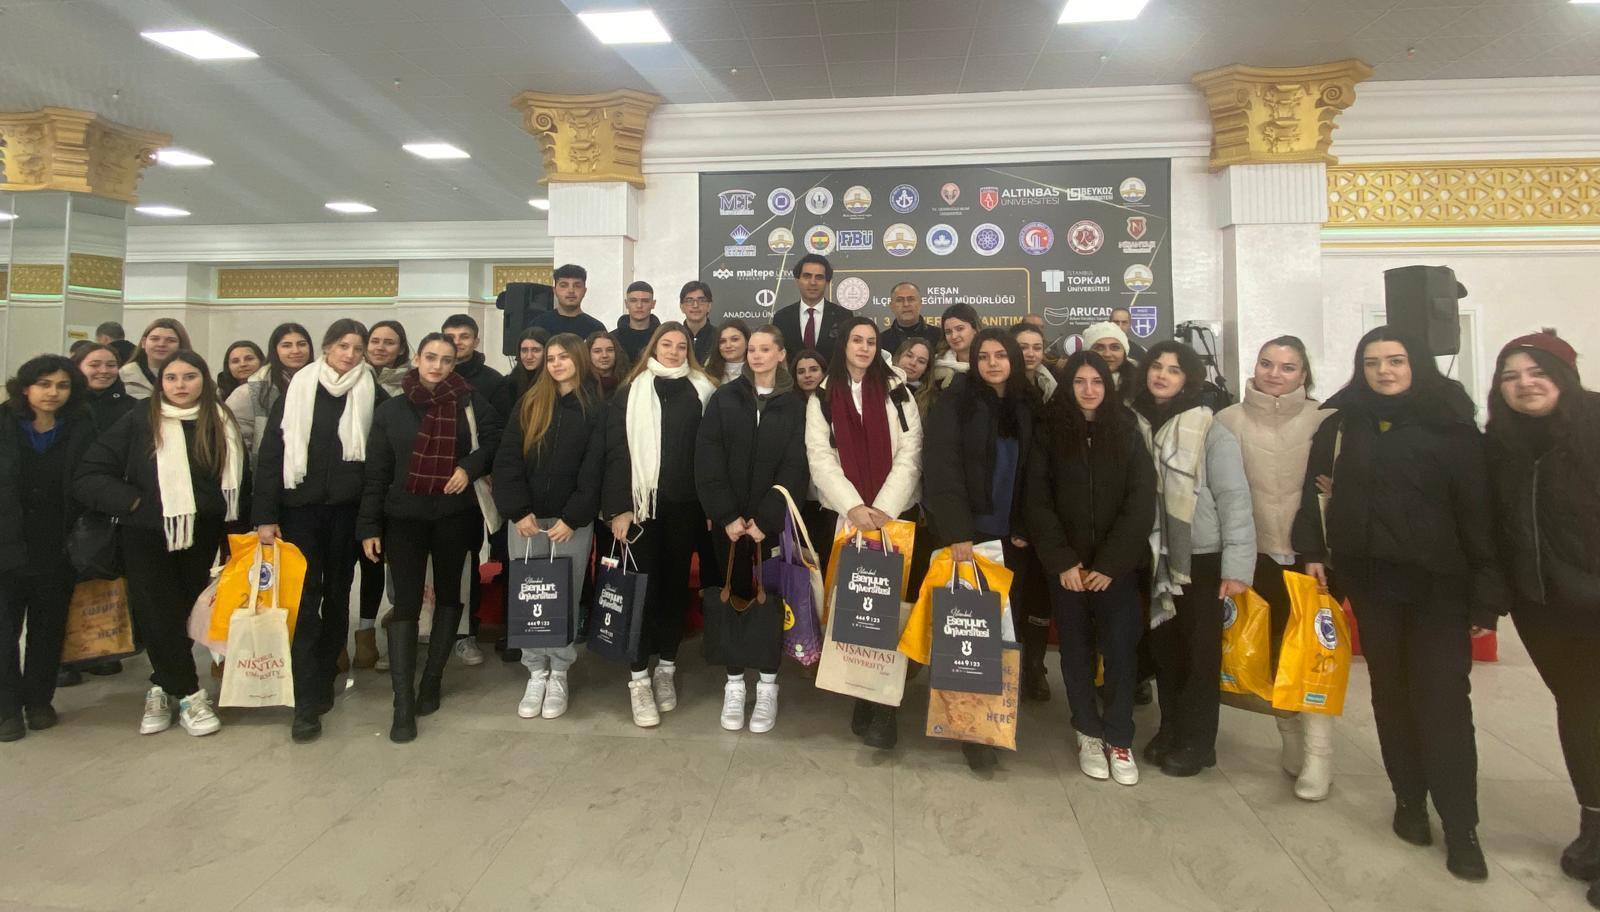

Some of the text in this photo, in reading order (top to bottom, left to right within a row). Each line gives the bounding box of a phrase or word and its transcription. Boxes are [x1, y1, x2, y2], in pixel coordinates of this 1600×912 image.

[736, 268, 775, 280] maltepe
[1067, 276, 1111, 285] TOPKAPI
[927, 287, 959, 298] KEŞAN
[921, 295, 953, 305] EĞİTİM
[954, 294, 1016, 305] MÜDÜRLÜĞÜ
[723, 311, 761, 319] ANADOLU
